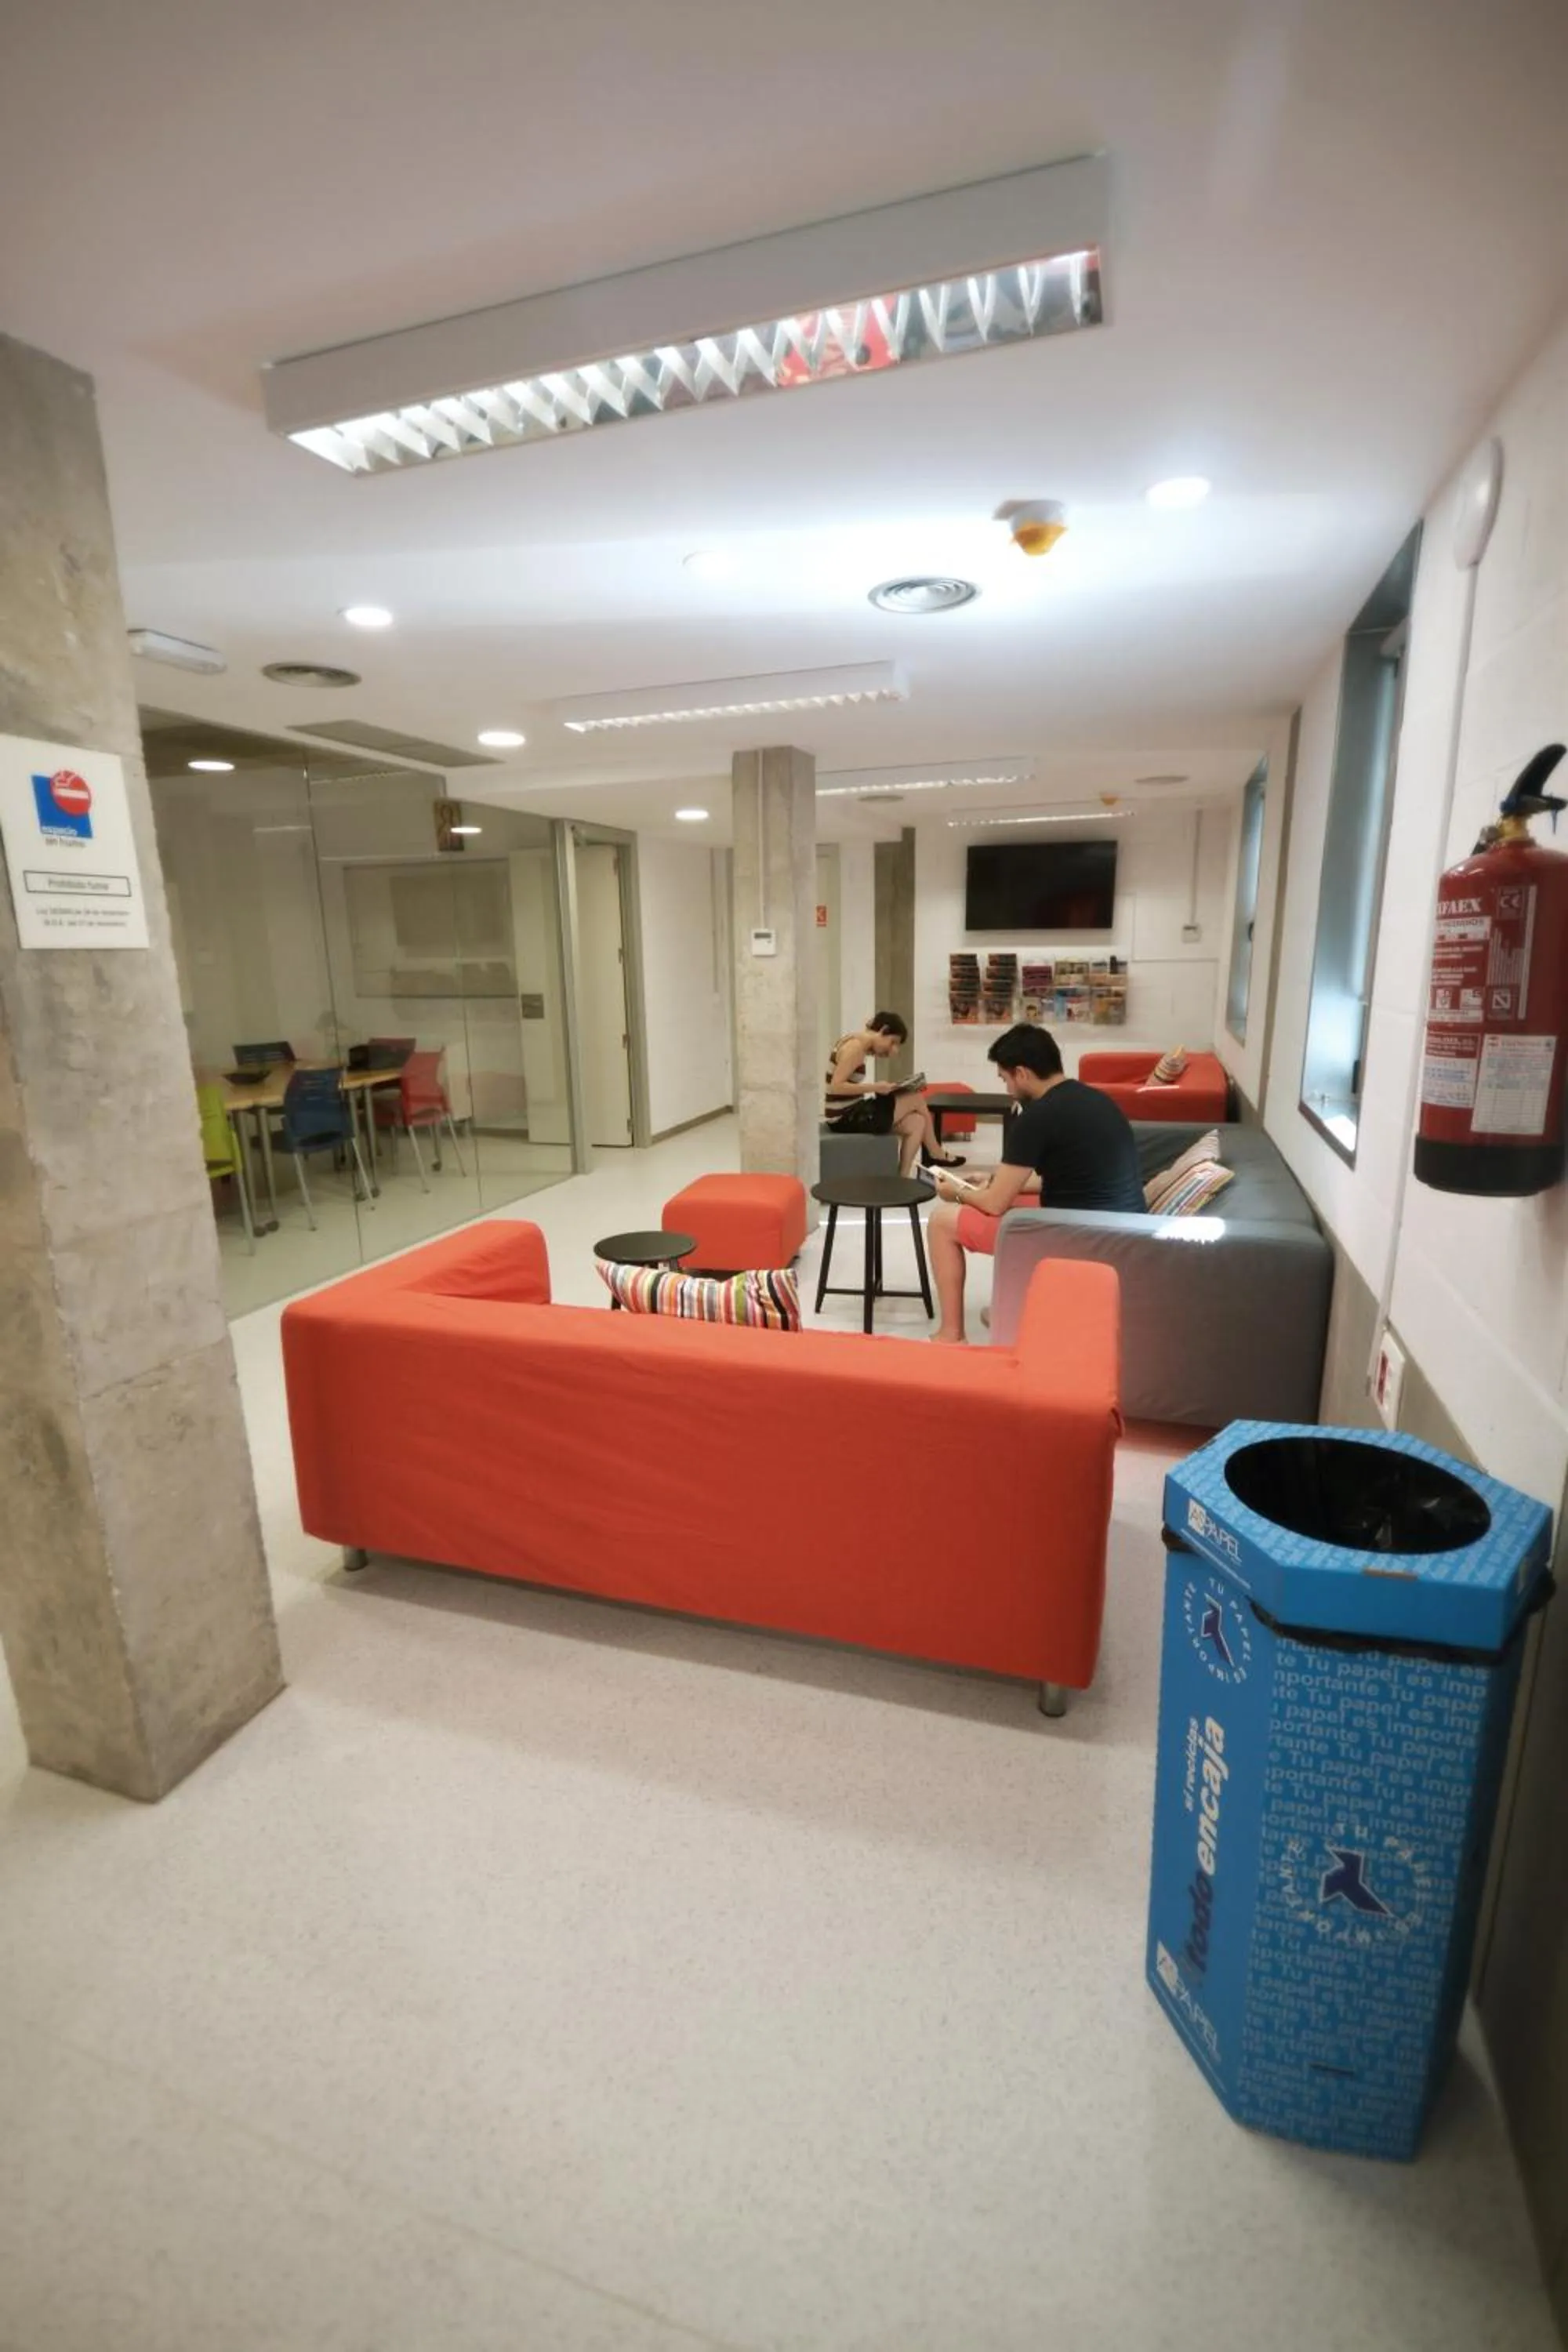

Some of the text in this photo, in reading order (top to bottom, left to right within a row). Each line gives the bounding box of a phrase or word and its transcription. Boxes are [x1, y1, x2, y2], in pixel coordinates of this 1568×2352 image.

[1303, 1653, 1329, 1671] Tu
[1337, 1660, 1399, 1684] papel
[1406, 1674, 1432, 1688] es
[1306, 1688, 1330, 1704] Tu
[1338, 1693, 1400, 1719] papel
[1407, 1708, 1434, 1723] es
[1387, 1683, 1415, 1702] Tu
[1286, 1699, 1345, 1726] papel
[1352, 1715, 1377, 1730] es
[1336, 1742, 1362, 1760] Tu
[1370, 1748, 1432, 1773] papel
[1368, 1731, 1393, 1748] Tu
[1401, 1740, 1465, 1763] papel
[1289, 1750, 1313, 1768] Tu
[1320, 1758, 1381, 1780] papel
[1196, 1715, 1230, 1877] encaja
[1290, 1783, 1316, 1799] Tu
[1368, 1780, 1396, 1798] Tu
